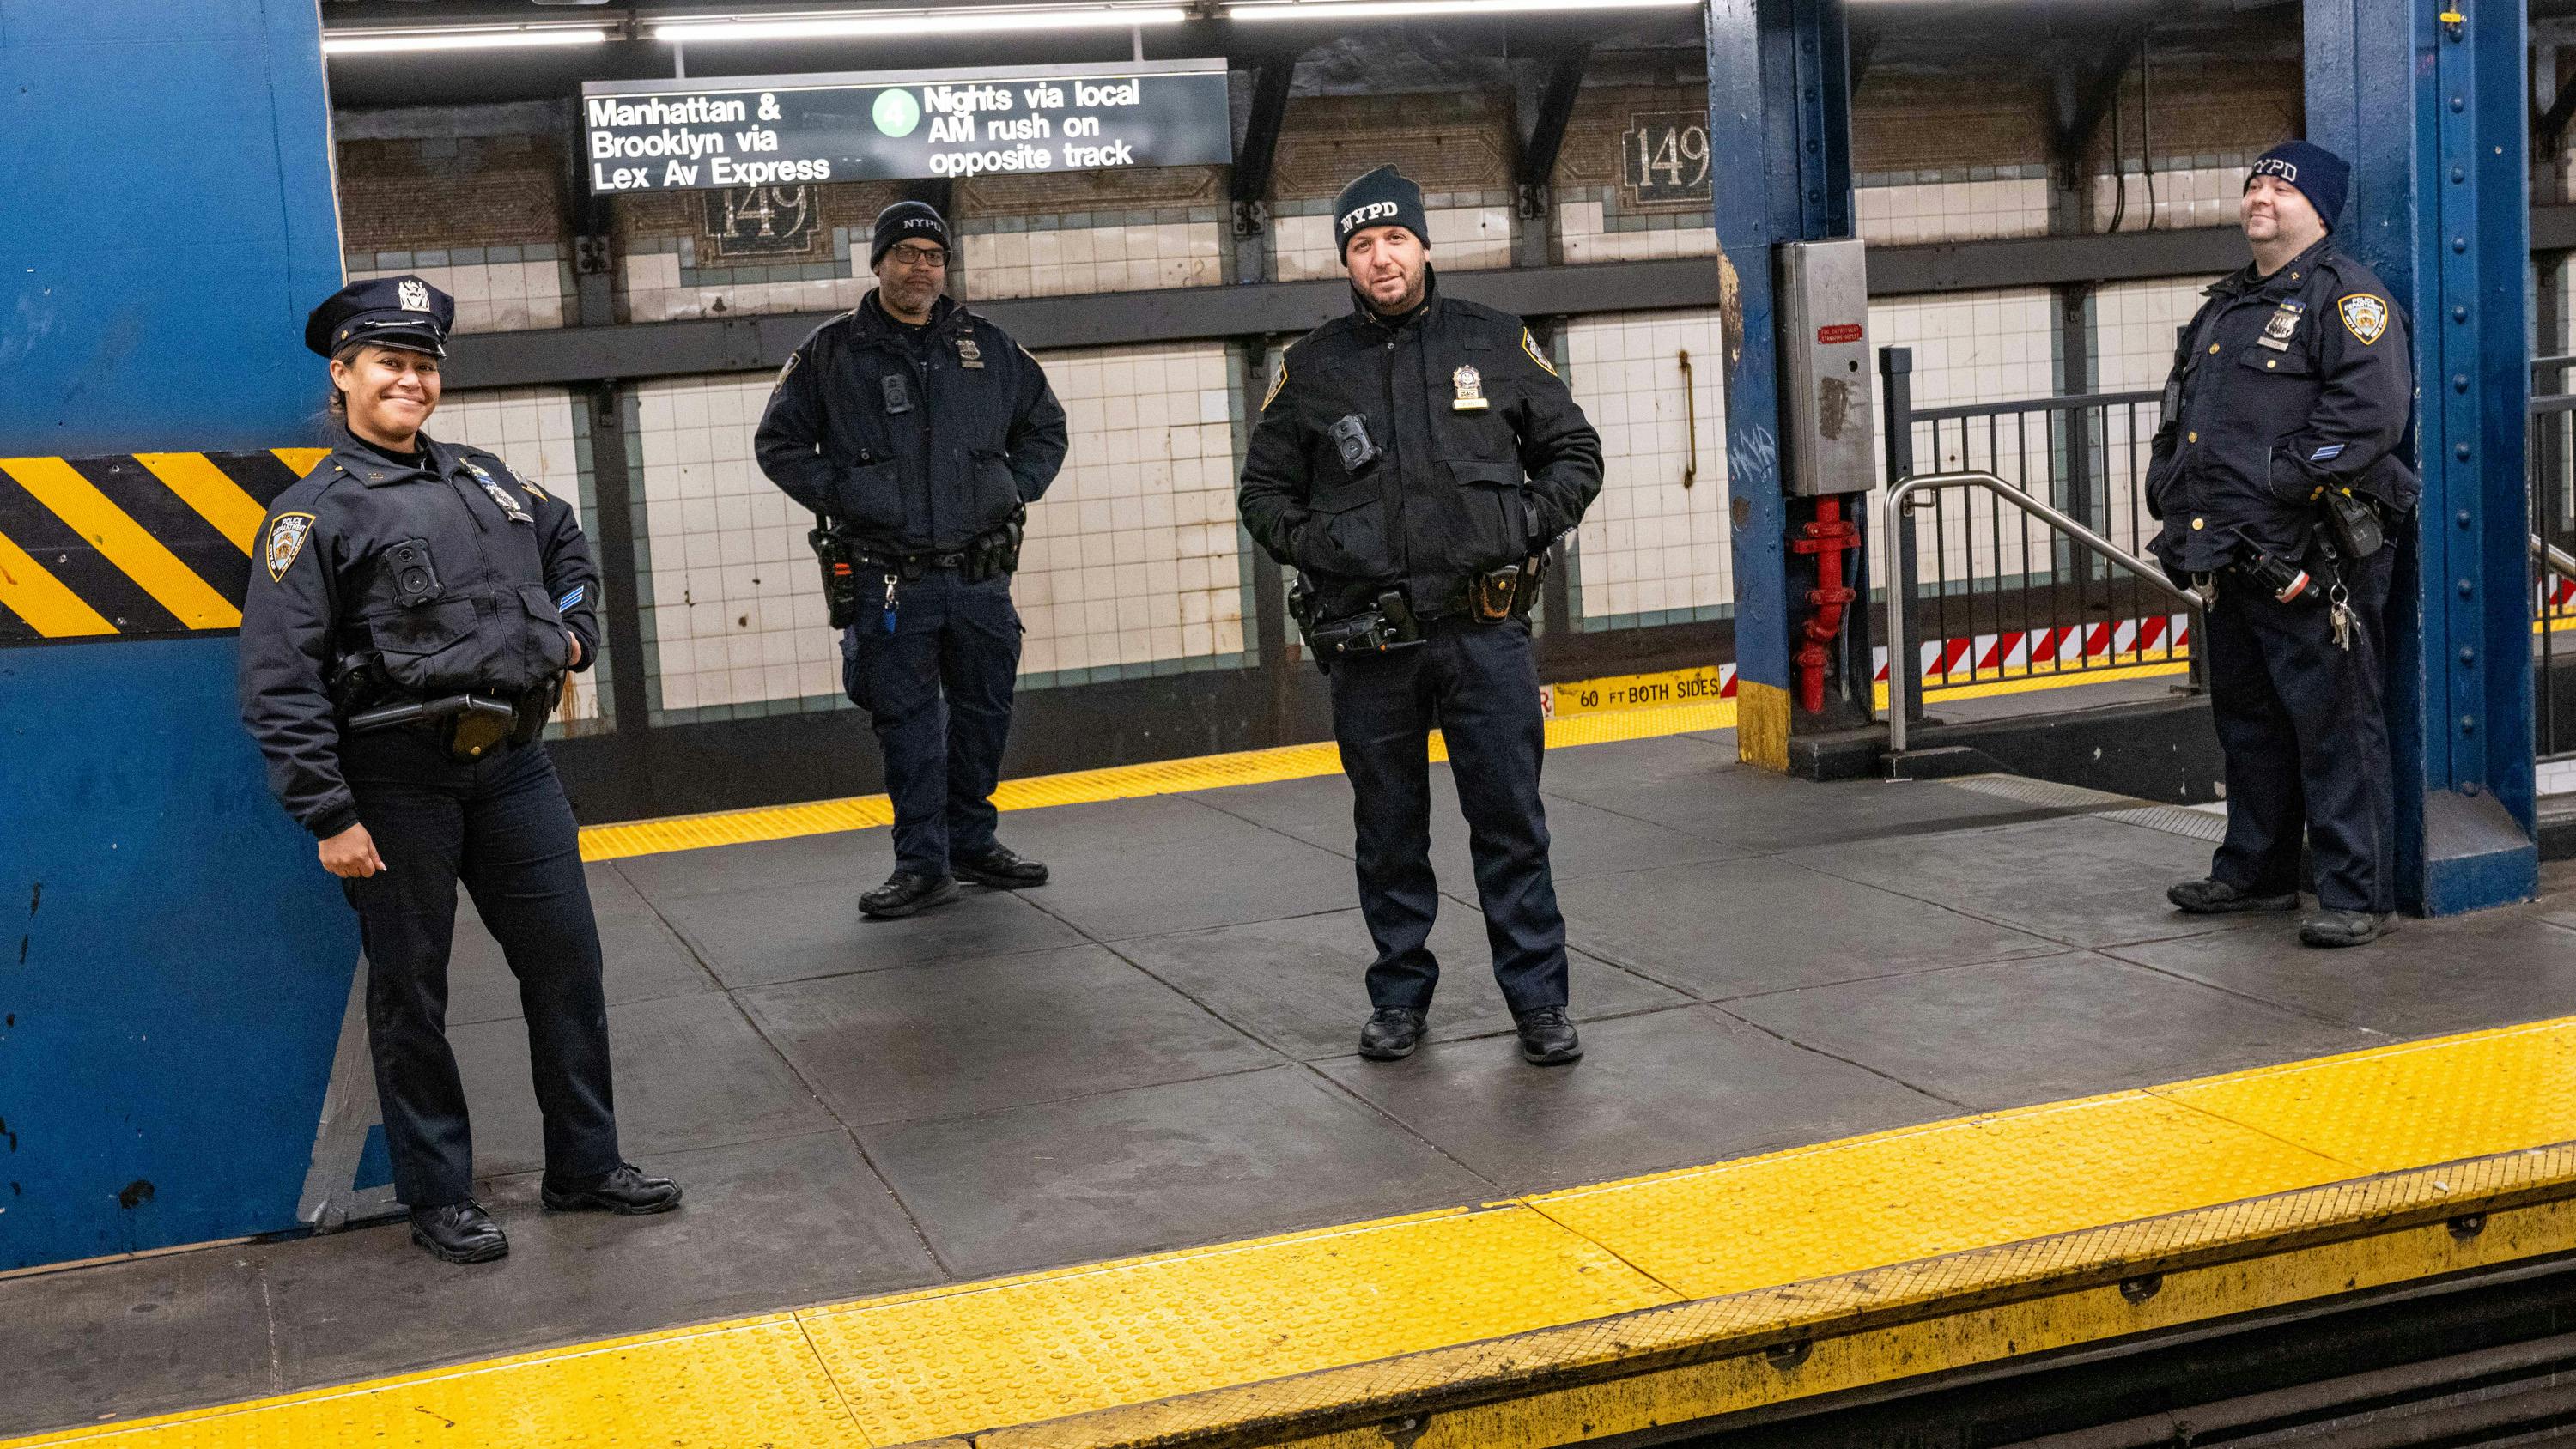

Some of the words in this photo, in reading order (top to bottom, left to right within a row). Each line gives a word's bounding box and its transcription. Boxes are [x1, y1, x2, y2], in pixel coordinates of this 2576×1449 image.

[588, 97, 746, 127] Manhattan
[757, 93, 781, 121] &
[923, 85, 1013, 118] Nights
[1024, 82, 1064, 108] via
[1074, 78, 1140, 106] local
[592, 128, 724, 160] Brooklyn
[736, 124, 778, 152] via
[927, 115, 975, 143] AM
[987, 112, 1050, 141] rush
[1063, 116, 1100, 138] on
[929, 144, 1052, 179] opposite
[1063, 139, 1133, 167] track
[1637, 126, 1710, 187] 149
[2253, 159, 2297, 182] YPD
[594, 163, 650, 190] Lex
[663, 160, 699, 187] Av
[711, 157, 830, 187] Express
[904, 219, 941, 233] NYPD
[1340, 201, 1398, 233] NYPD
[272, 524, 307, 537] DEPARTMENT
[282, 517, 302, 525] POLICE
[1580, 690, 1598, 707] 60
[1609, 691, 1625, 703] FT
[1629, 683, 1668, 704] BOTH
[1677, 678, 1719, 699] SIDES
